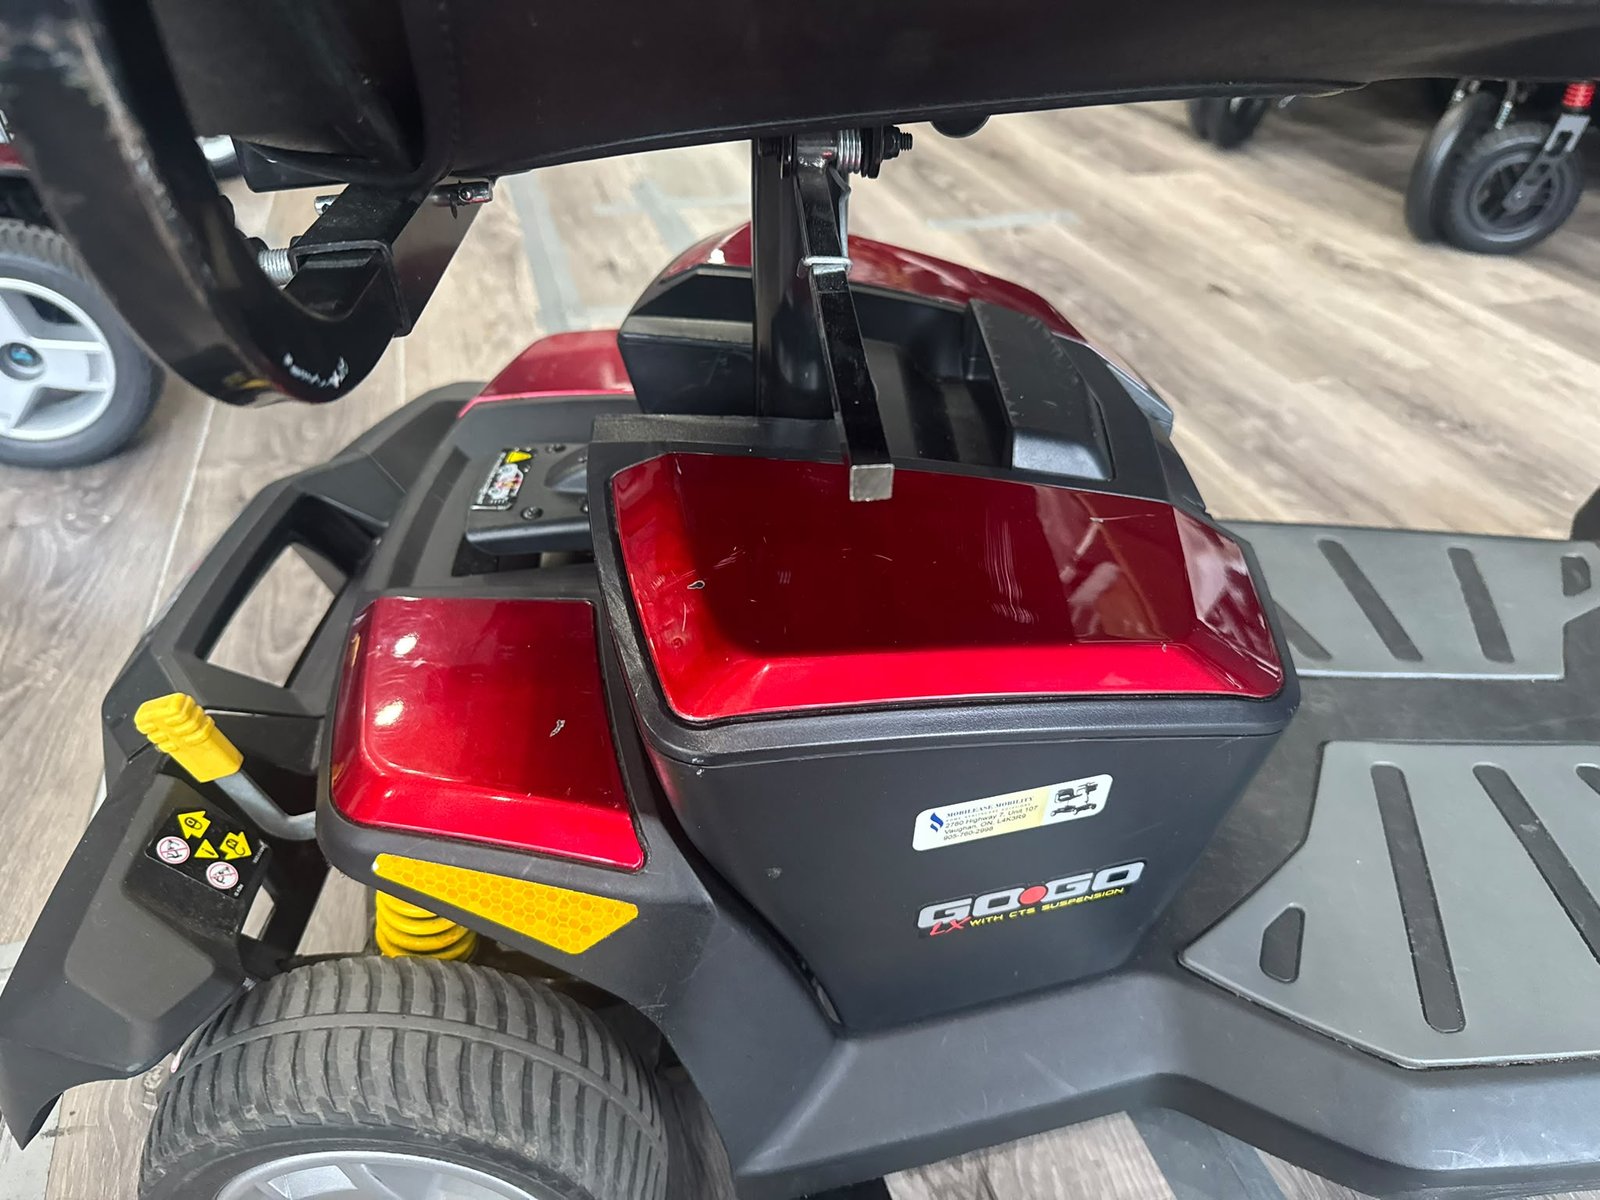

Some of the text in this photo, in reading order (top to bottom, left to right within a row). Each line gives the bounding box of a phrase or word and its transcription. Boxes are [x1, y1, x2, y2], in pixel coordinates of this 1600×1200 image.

[965, 814, 997, 825] Highway
[1008, 808, 1023, 816] Unit
[1025, 805, 1039, 813] 107
[929, 887, 1125, 936] LX WITH CTS SUSPENSION
